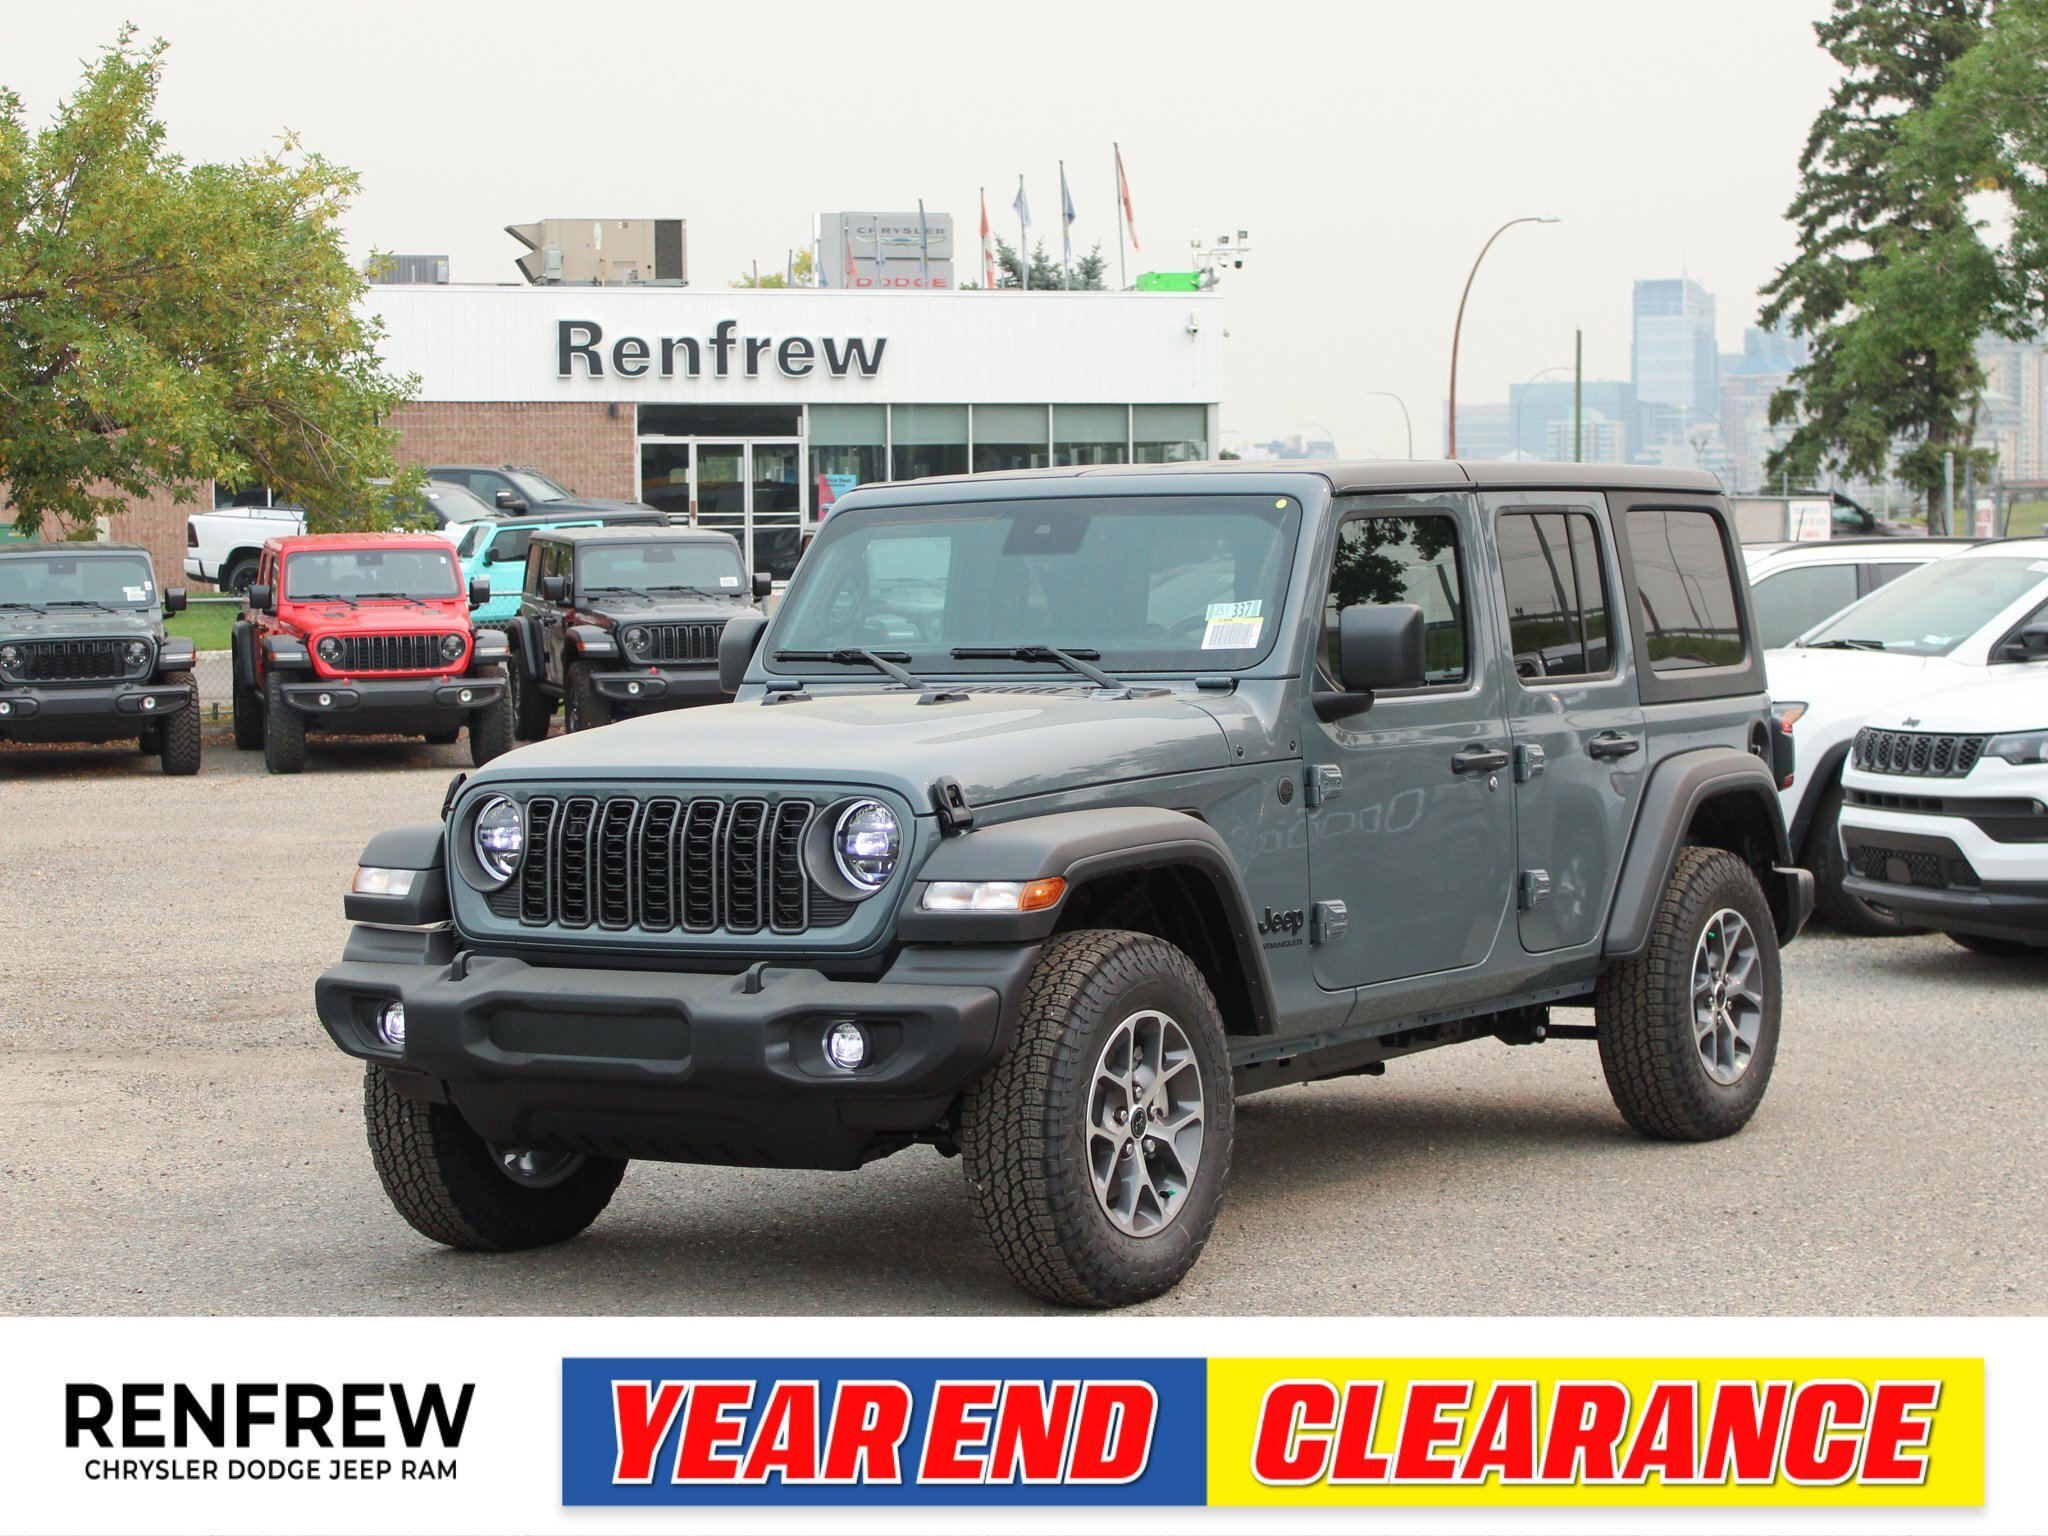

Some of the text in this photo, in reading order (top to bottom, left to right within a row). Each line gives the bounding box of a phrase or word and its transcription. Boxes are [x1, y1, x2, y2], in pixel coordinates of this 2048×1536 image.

[556, 319, 889, 379] Renfrew
[1232, 602, 1252, 618] 337
[1258, 906, 1304, 935] Jeep
